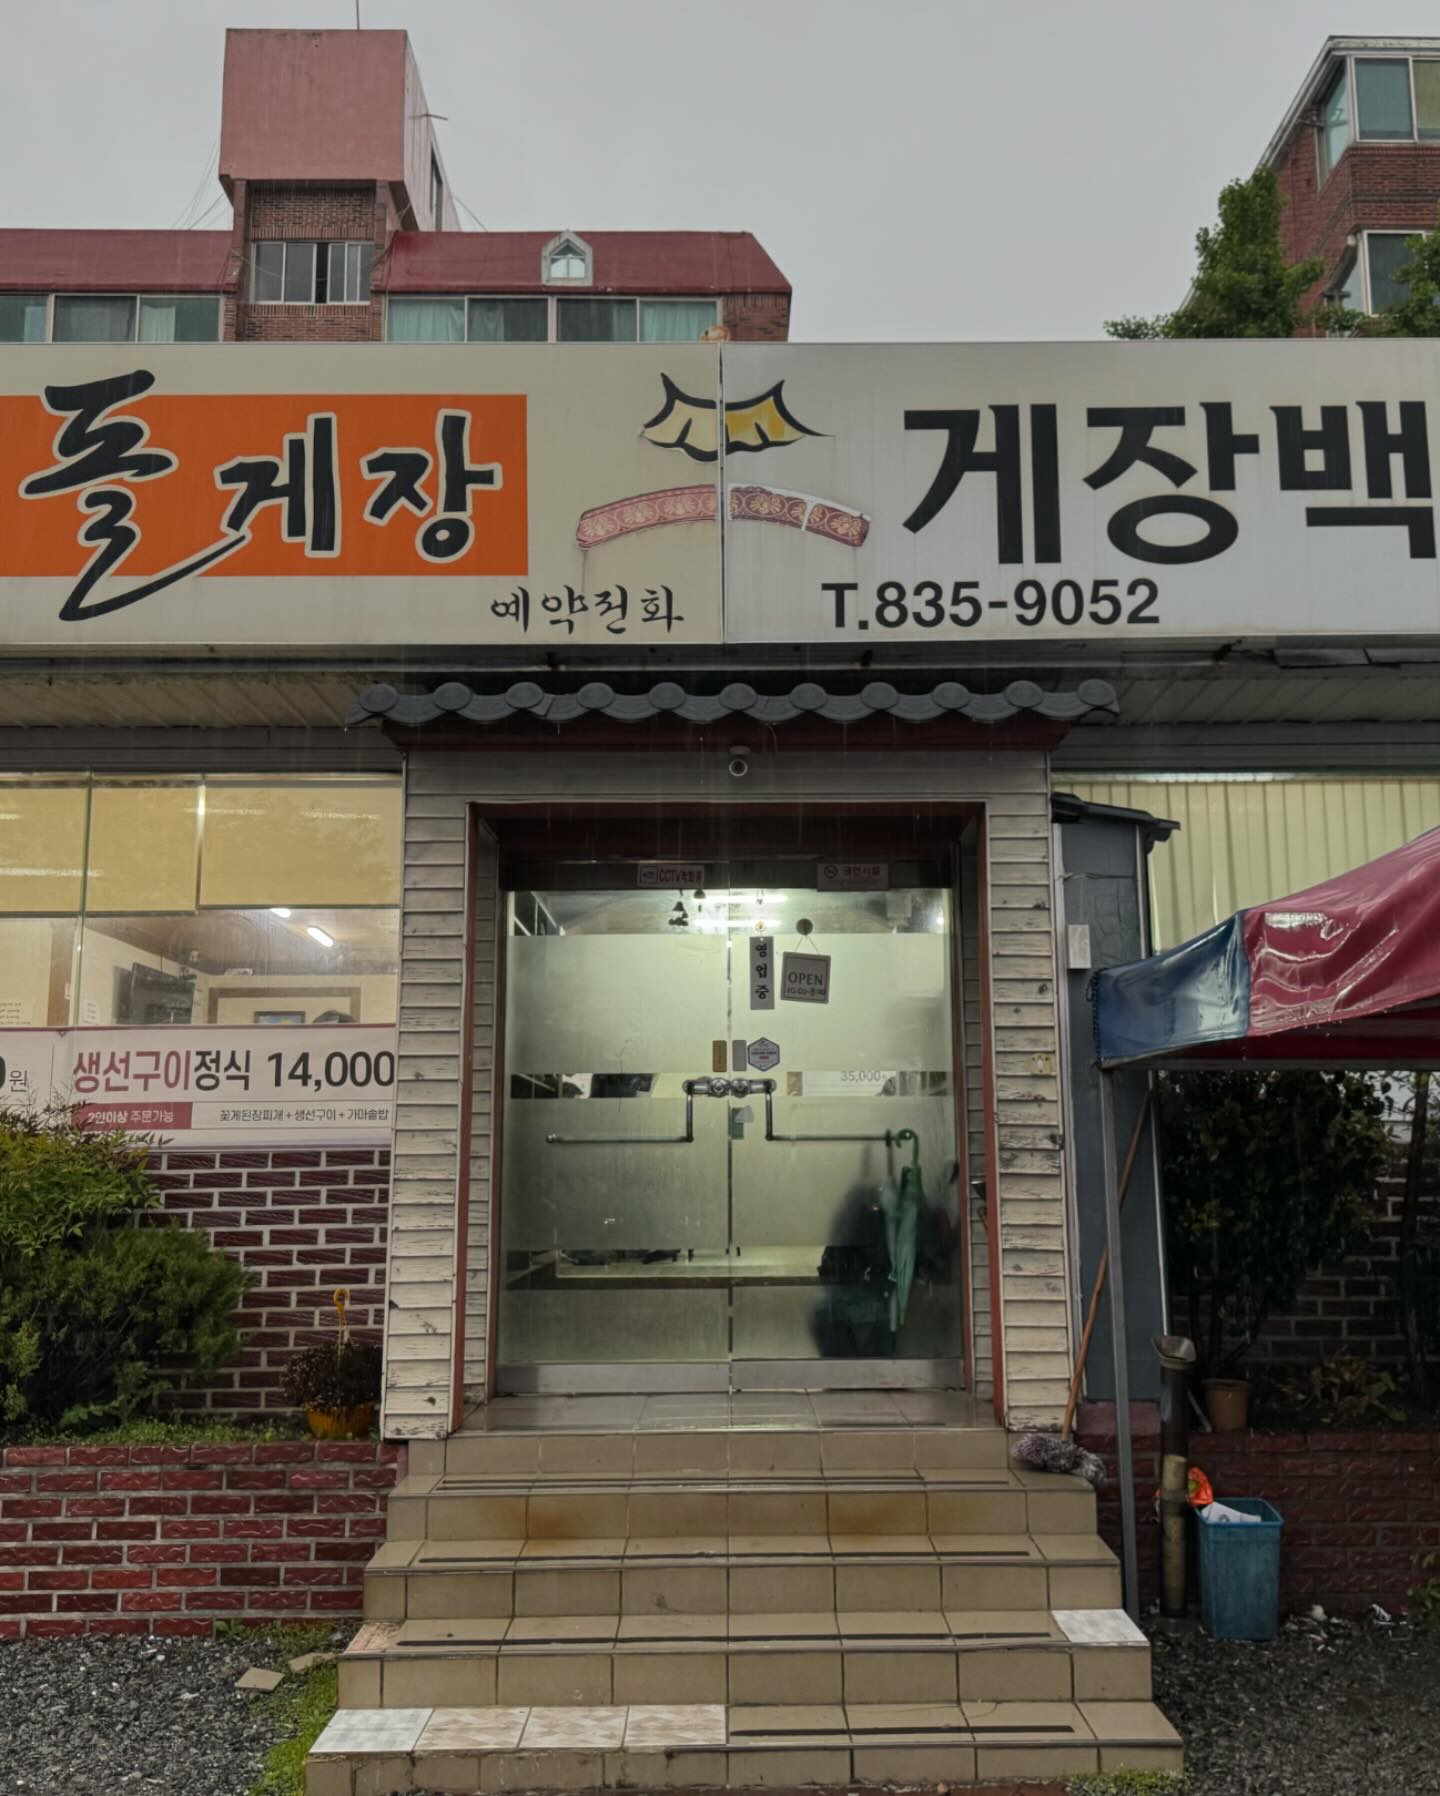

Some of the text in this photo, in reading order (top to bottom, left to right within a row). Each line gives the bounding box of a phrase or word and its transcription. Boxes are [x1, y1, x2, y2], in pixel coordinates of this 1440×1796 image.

[902, 401, 1437, 565] 게장백
[490, 584, 685, 635] 예약전화
[821, 578, 1160, 630] T.835-9052
[788, 971, 824, 986] OPEN
[267, 1051, 395, 1092] 14,000
[87, 1109, 174, 1124] 2인이상 주문가능
[294, 1108, 336, 1122] 생선구이
